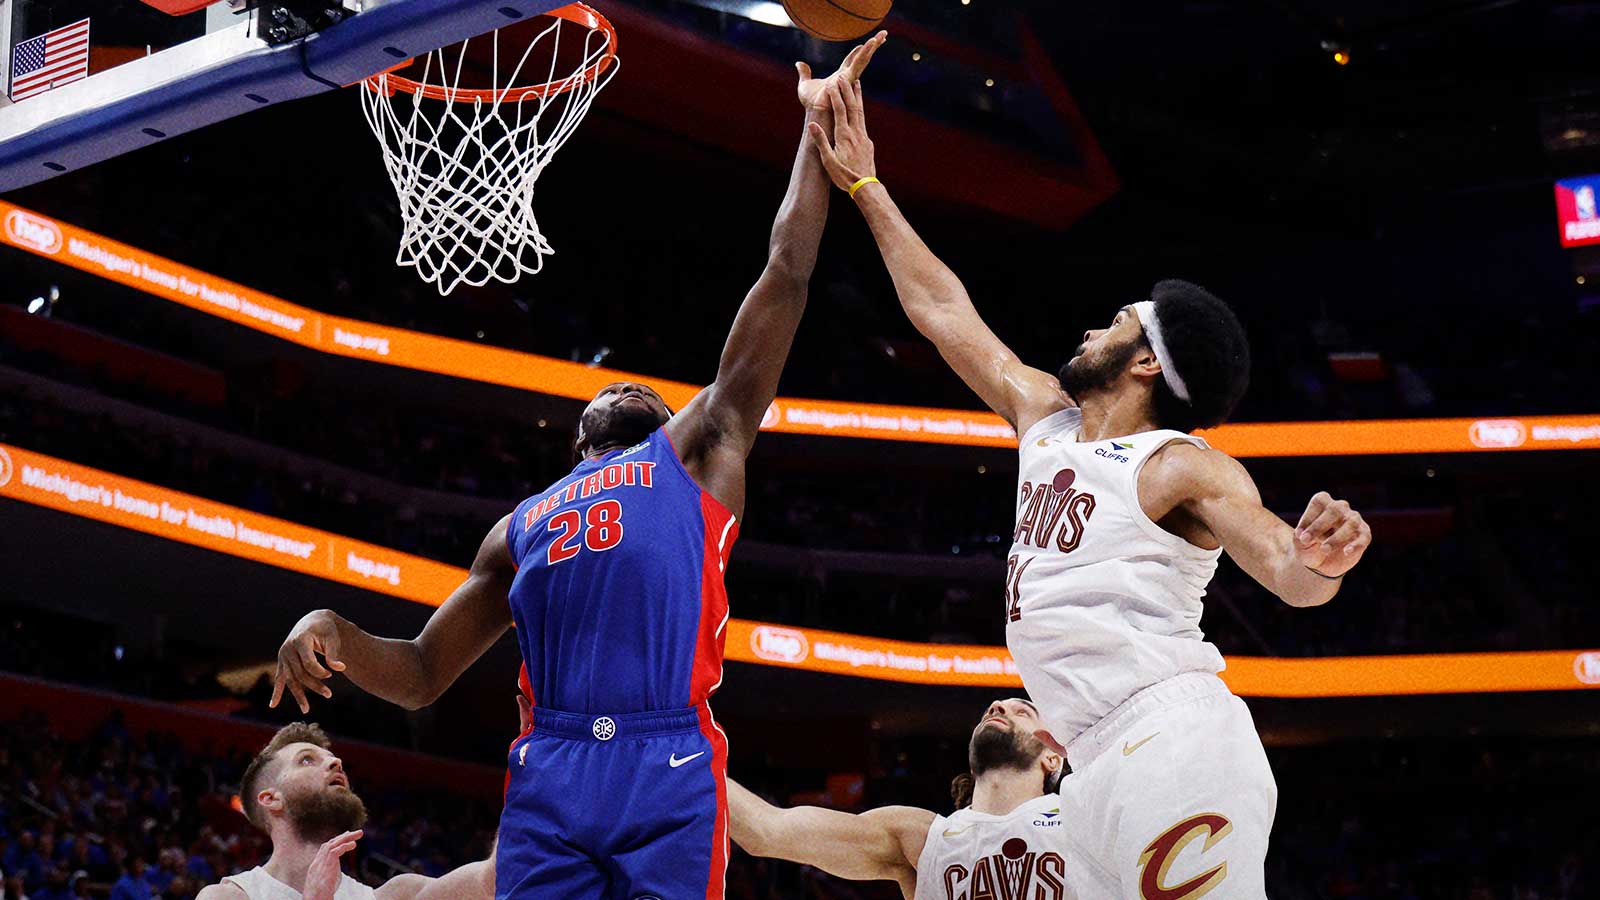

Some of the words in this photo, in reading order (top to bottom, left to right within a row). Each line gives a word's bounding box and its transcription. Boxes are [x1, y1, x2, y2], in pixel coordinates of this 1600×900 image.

[69, 238, 140, 277] Michigan's
[142, 264, 178, 290] home
[178, 276, 201, 297] for
[201, 283, 240, 312] health
[334, 327, 389, 355] hap.org
[787, 407, 861, 428] Michigan's
[862, 413, 899, 431] home
[901, 416, 921, 432] for
[923, 417, 966, 435] health
[1095, 448, 1129, 464] CLIFFS
[22, 464, 113, 507] Michigan's
[114, 489, 160, 519] home
[160, 501, 186, 525] for
[186, 508, 236, 539] health
[524, 461, 657, 532] DETROIT
[547, 499, 624, 565] 28
[347, 552, 400, 585] hap.org
[814, 642, 887, 667] Michigan's
[887, 650, 926, 672] home
[927, 653, 952, 672] for
[953, 655, 1003, 674] health
